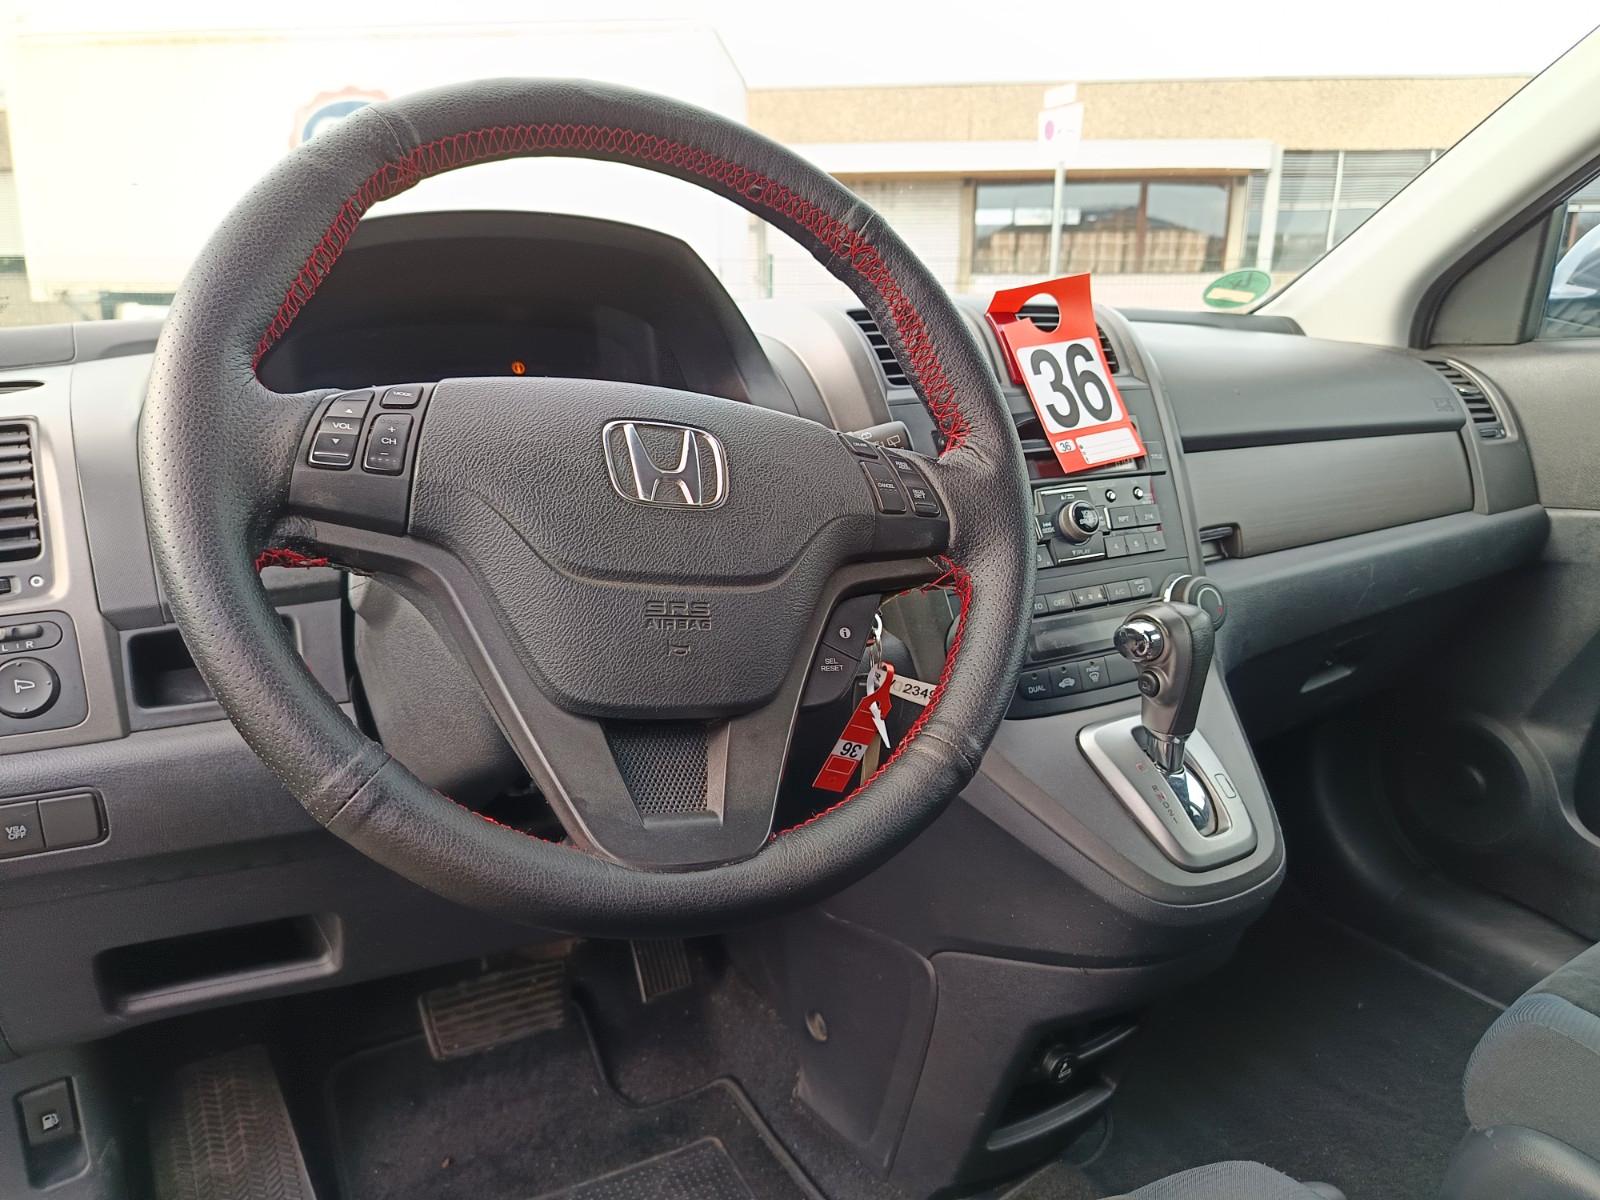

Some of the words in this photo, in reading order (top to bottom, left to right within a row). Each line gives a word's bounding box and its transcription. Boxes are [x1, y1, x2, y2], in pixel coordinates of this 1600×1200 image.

[1030, 342, 1113, 429] 36
[332, 422, 353, 430] VOL
[381, 437, 397, 445] CH
[1059, 441, 1072, 452] 36
[645, 600, 710, 616] SRS
[643, 617, 712, 631] AIRBAG
[25, 640, 34, 649] R
[824, 657, 839, 665] SEL
[1028, 684, 1047, 694] DUAL
